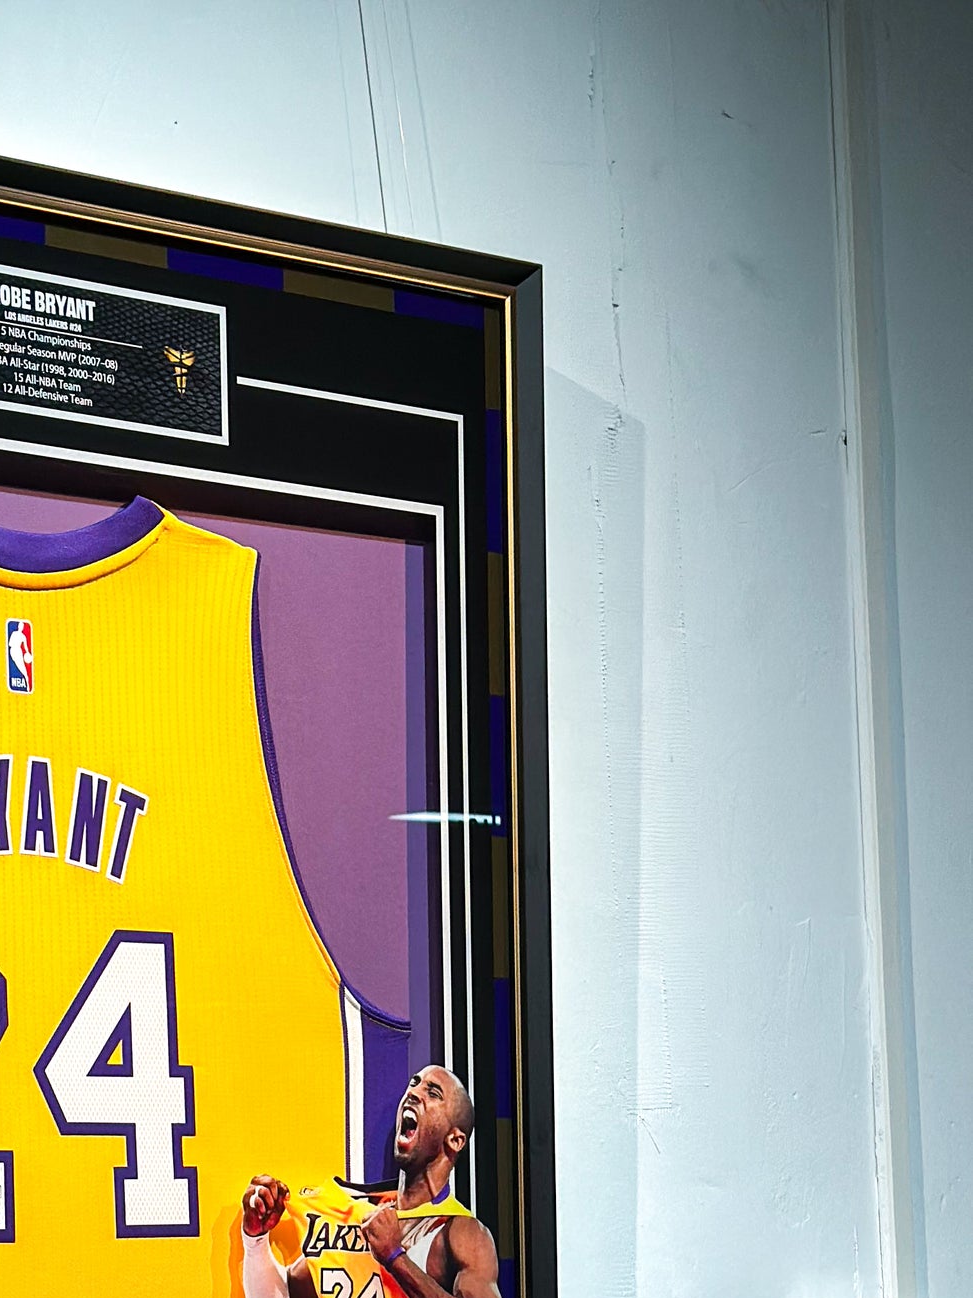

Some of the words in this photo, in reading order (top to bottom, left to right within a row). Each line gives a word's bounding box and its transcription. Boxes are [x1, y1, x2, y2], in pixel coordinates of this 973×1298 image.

[34, 290, 96, 321] BRYANT
[4, 310, 17, 321] LOS
[45, 317, 68, 330] LAKERS
[69, 322, 82, 333] #24
[1, 326, 7, 336] 5
[8, 327, 27, 340] NBA
[27, 331, 92, 351] Championships
[27, 345, 57, 359] Season
[58, 351, 77, 363] MVP
[10, 357, 40, 371] All-Star
[41, 362, 67, 377] (1998,
[14, 372, 24, 383] 15
[25, 374, 57, 388] All-NBA
[58, 379, 81, 392] Team
[3, 383, 13, 394] 12
[14, 385, 68, 403] All-Defensive
[69, 393, 93, 407] Team
[11, 677, 26, 688] NBA
[302, 1213, 370, 1257] LAKE
